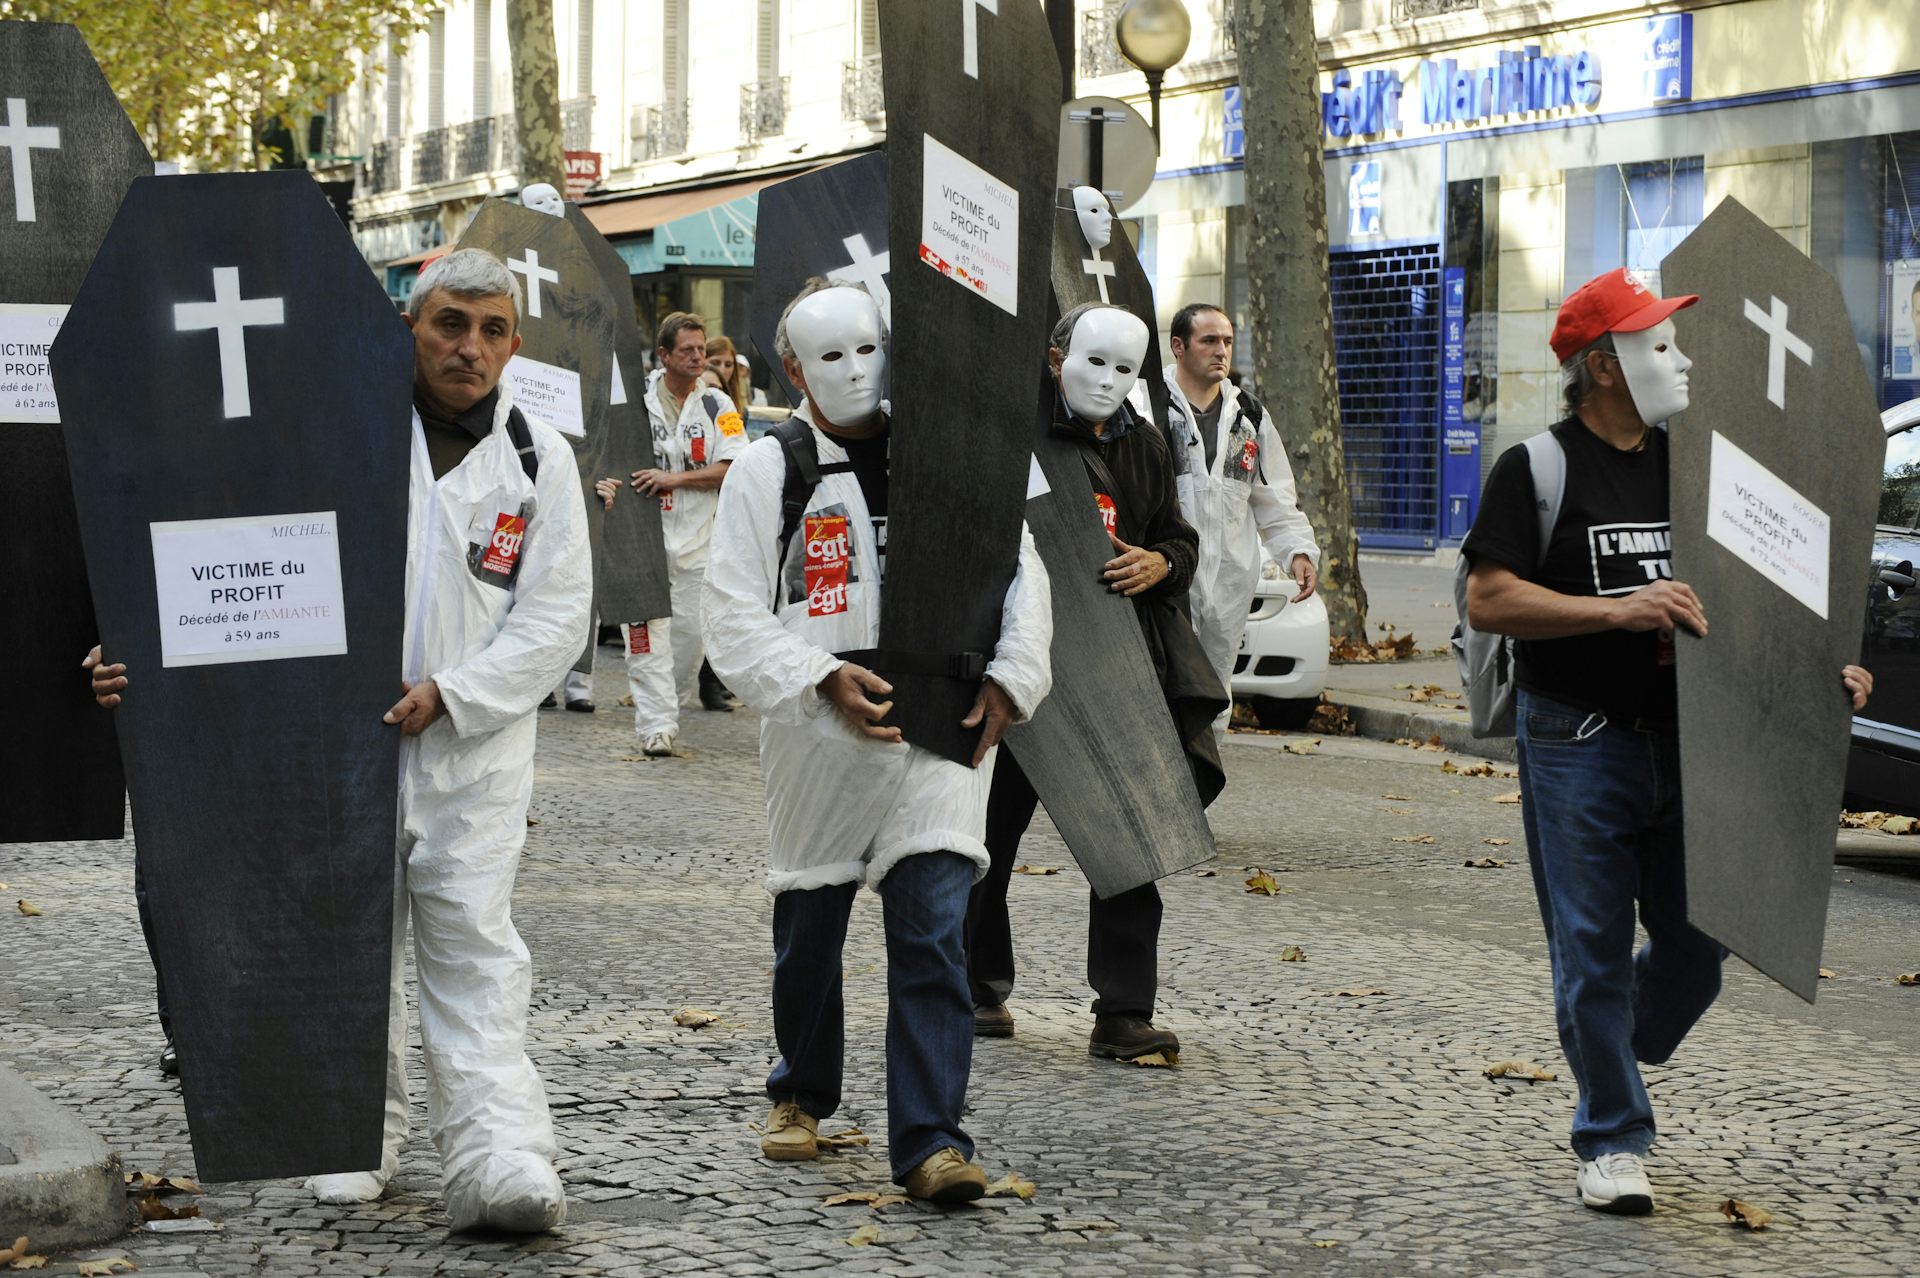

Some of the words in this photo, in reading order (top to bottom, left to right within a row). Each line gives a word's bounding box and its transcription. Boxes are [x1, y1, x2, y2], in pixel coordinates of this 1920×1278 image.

[1420, 45, 1602, 125] Maritime
[942, 184, 985, 221] VICTIME
[988, 213, 1001, 230] du
[727, 224, 744, 245] le
[951, 211, 989, 244] PROFIT
[933, 221, 959, 244] Décédé
[961, 238, 970, 250] de
[972, 241, 1012, 276] l'AMIANTE
[971, 262, 984, 276] ans
[5, 363, 50, 376] PROFI
[21, 382, 34, 392] de
[512, 374, 552, 392] VICTIME
[554, 386, 566, 396] du
[521, 387, 556, 403] PROFIT
[15, 398, 21, 408] à
[23, 398, 36, 408] 62
[38, 400, 56, 408] ans
[1734, 482, 1788, 529] VICTIME
[1791, 524, 1807, 545] du
[1722, 510, 1755, 539] Décédé
[1757, 535, 1768, 547] de
[1745, 508, 1794, 550] PROFIT
[493, 530, 523, 557] cgt
[806, 533, 848, 562] cgt
[192, 561, 274, 581] VICTIME
[281, 560, 305, 575] du
[1770, 560, 1787, 576] ans
[211, 584, 285, 604] PROFIT
[808, 583, 845, 613] cgt
[179, 612, 229, 626] Décédé
[233, 611, 249, 622] de
[253, 605, 330, 621] l'AMIANTE
[225, 631, 232, 642] à
[235, 630, 251, 641] 59
[256, 630, 280, 640] ans
